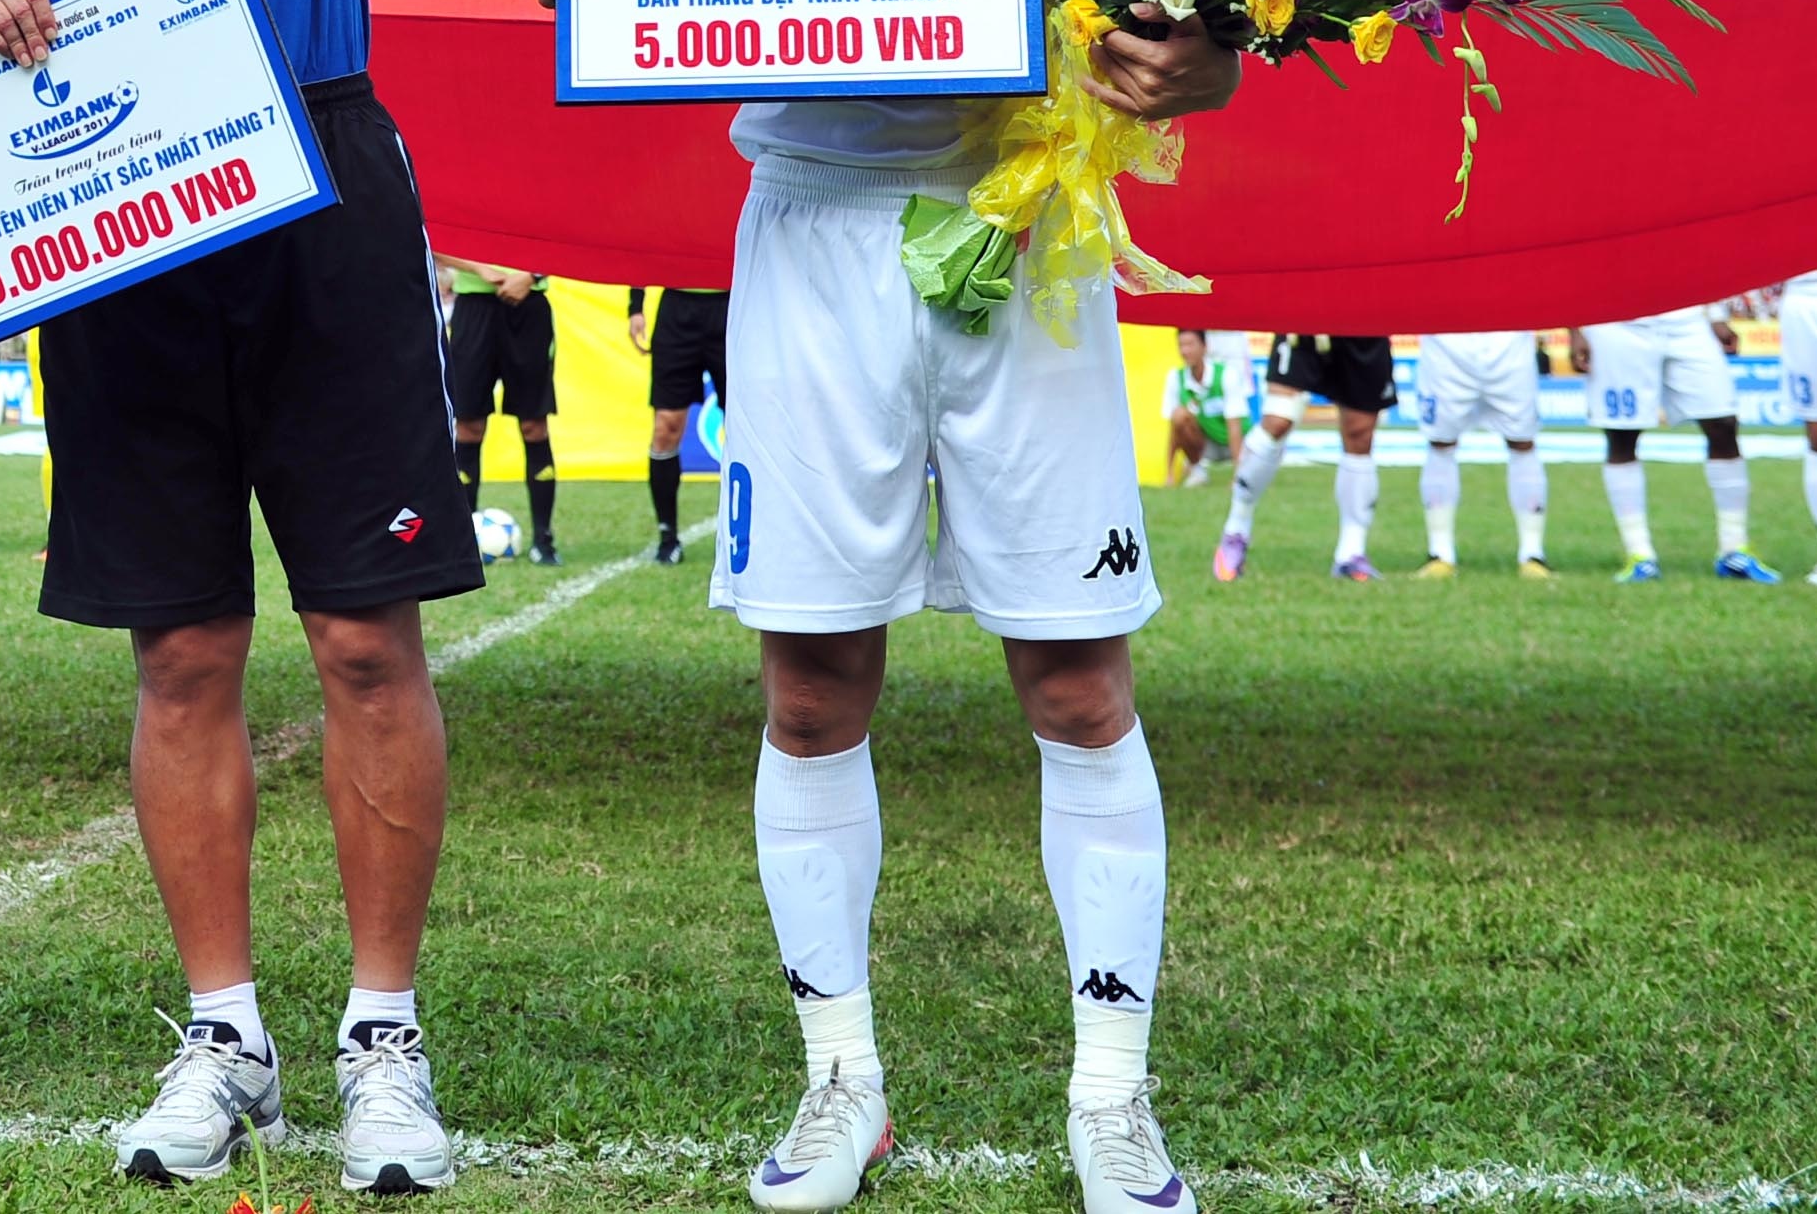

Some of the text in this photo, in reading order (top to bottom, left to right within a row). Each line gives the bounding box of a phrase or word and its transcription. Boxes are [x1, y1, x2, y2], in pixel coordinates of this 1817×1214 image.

[85, 5, 100, 19] GIA
[105, 5, 139, 28] 2011
[634, 15, 964, 69] 5.000.000 VNĐ
[9, 91, 119, 149] EXIMBANK
[31, 115, 111, 154] V-LEAGUE 2011
[29, 191, 69, 223] VIÊN
[70, 168, 114, 207] XUẤT
[119, 155, 154, 187] SẮC
[157, 132, 202, 172] NHẤT
[203, 111, 264, 154] THÁNG
[263, 105, 277, 126] 7
[55, 157, 93, 179] trọng
[97, 143, 126, 163] trao
[170, 157, 258, 226] VNĐ
[1276, 340, 1292, 375] 1
[1604, 388, 1638, 419] 99
[728, 461, 753, 575] 9
[189, 1028, 210, 1040] NIKE
